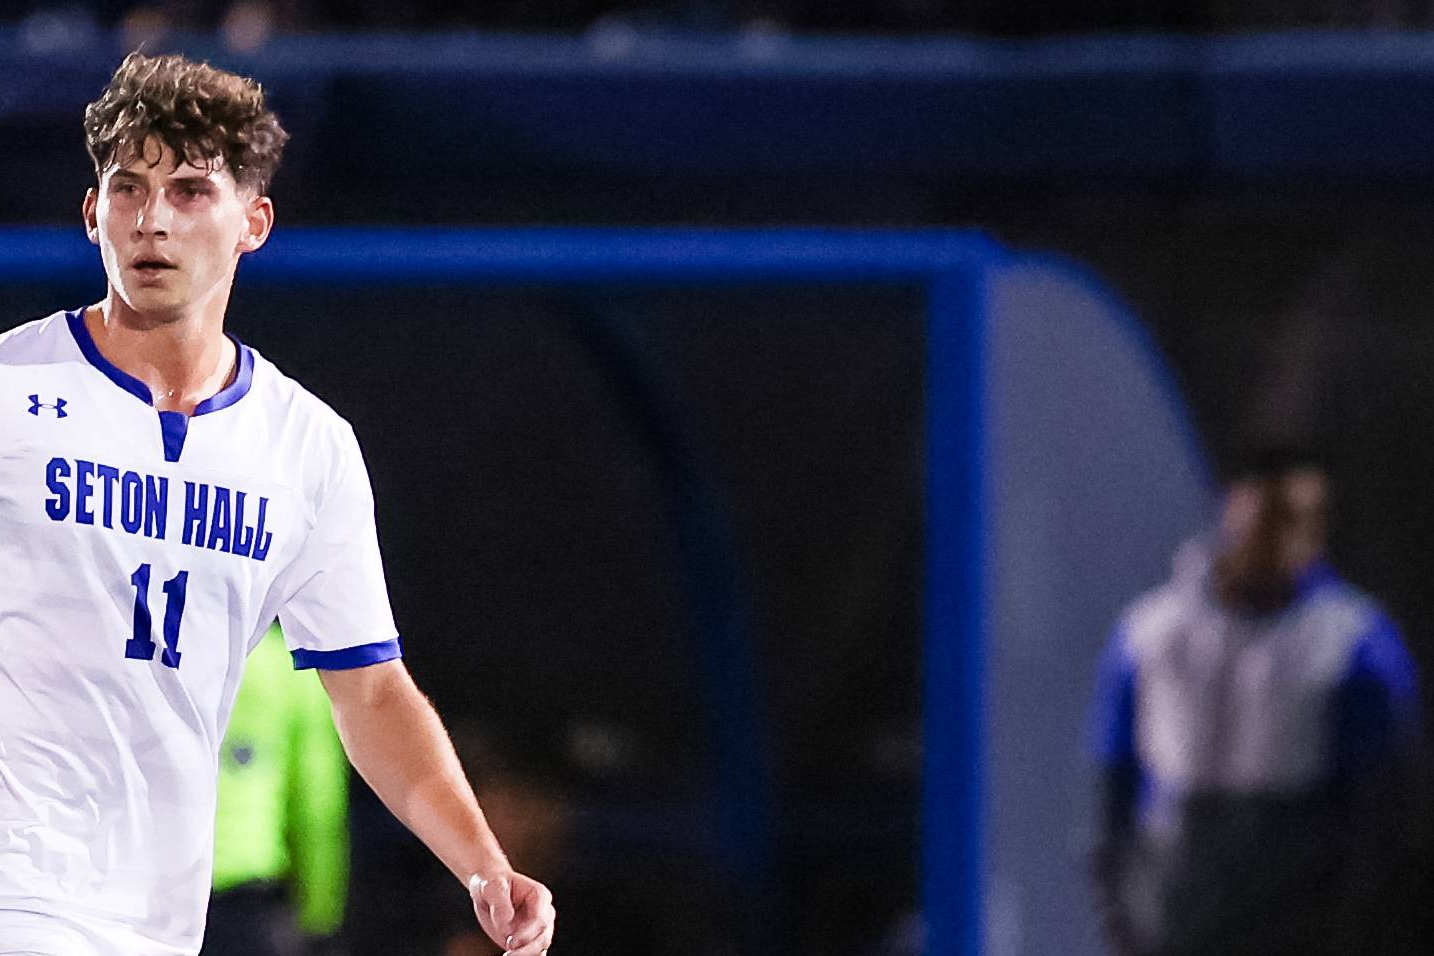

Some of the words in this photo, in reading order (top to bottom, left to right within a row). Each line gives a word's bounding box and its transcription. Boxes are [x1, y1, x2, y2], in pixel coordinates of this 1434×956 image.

[45, 457, 170, 540] SETON
[181, 481, 273, 561] HALL
[124, 563, 189, 670] 11
